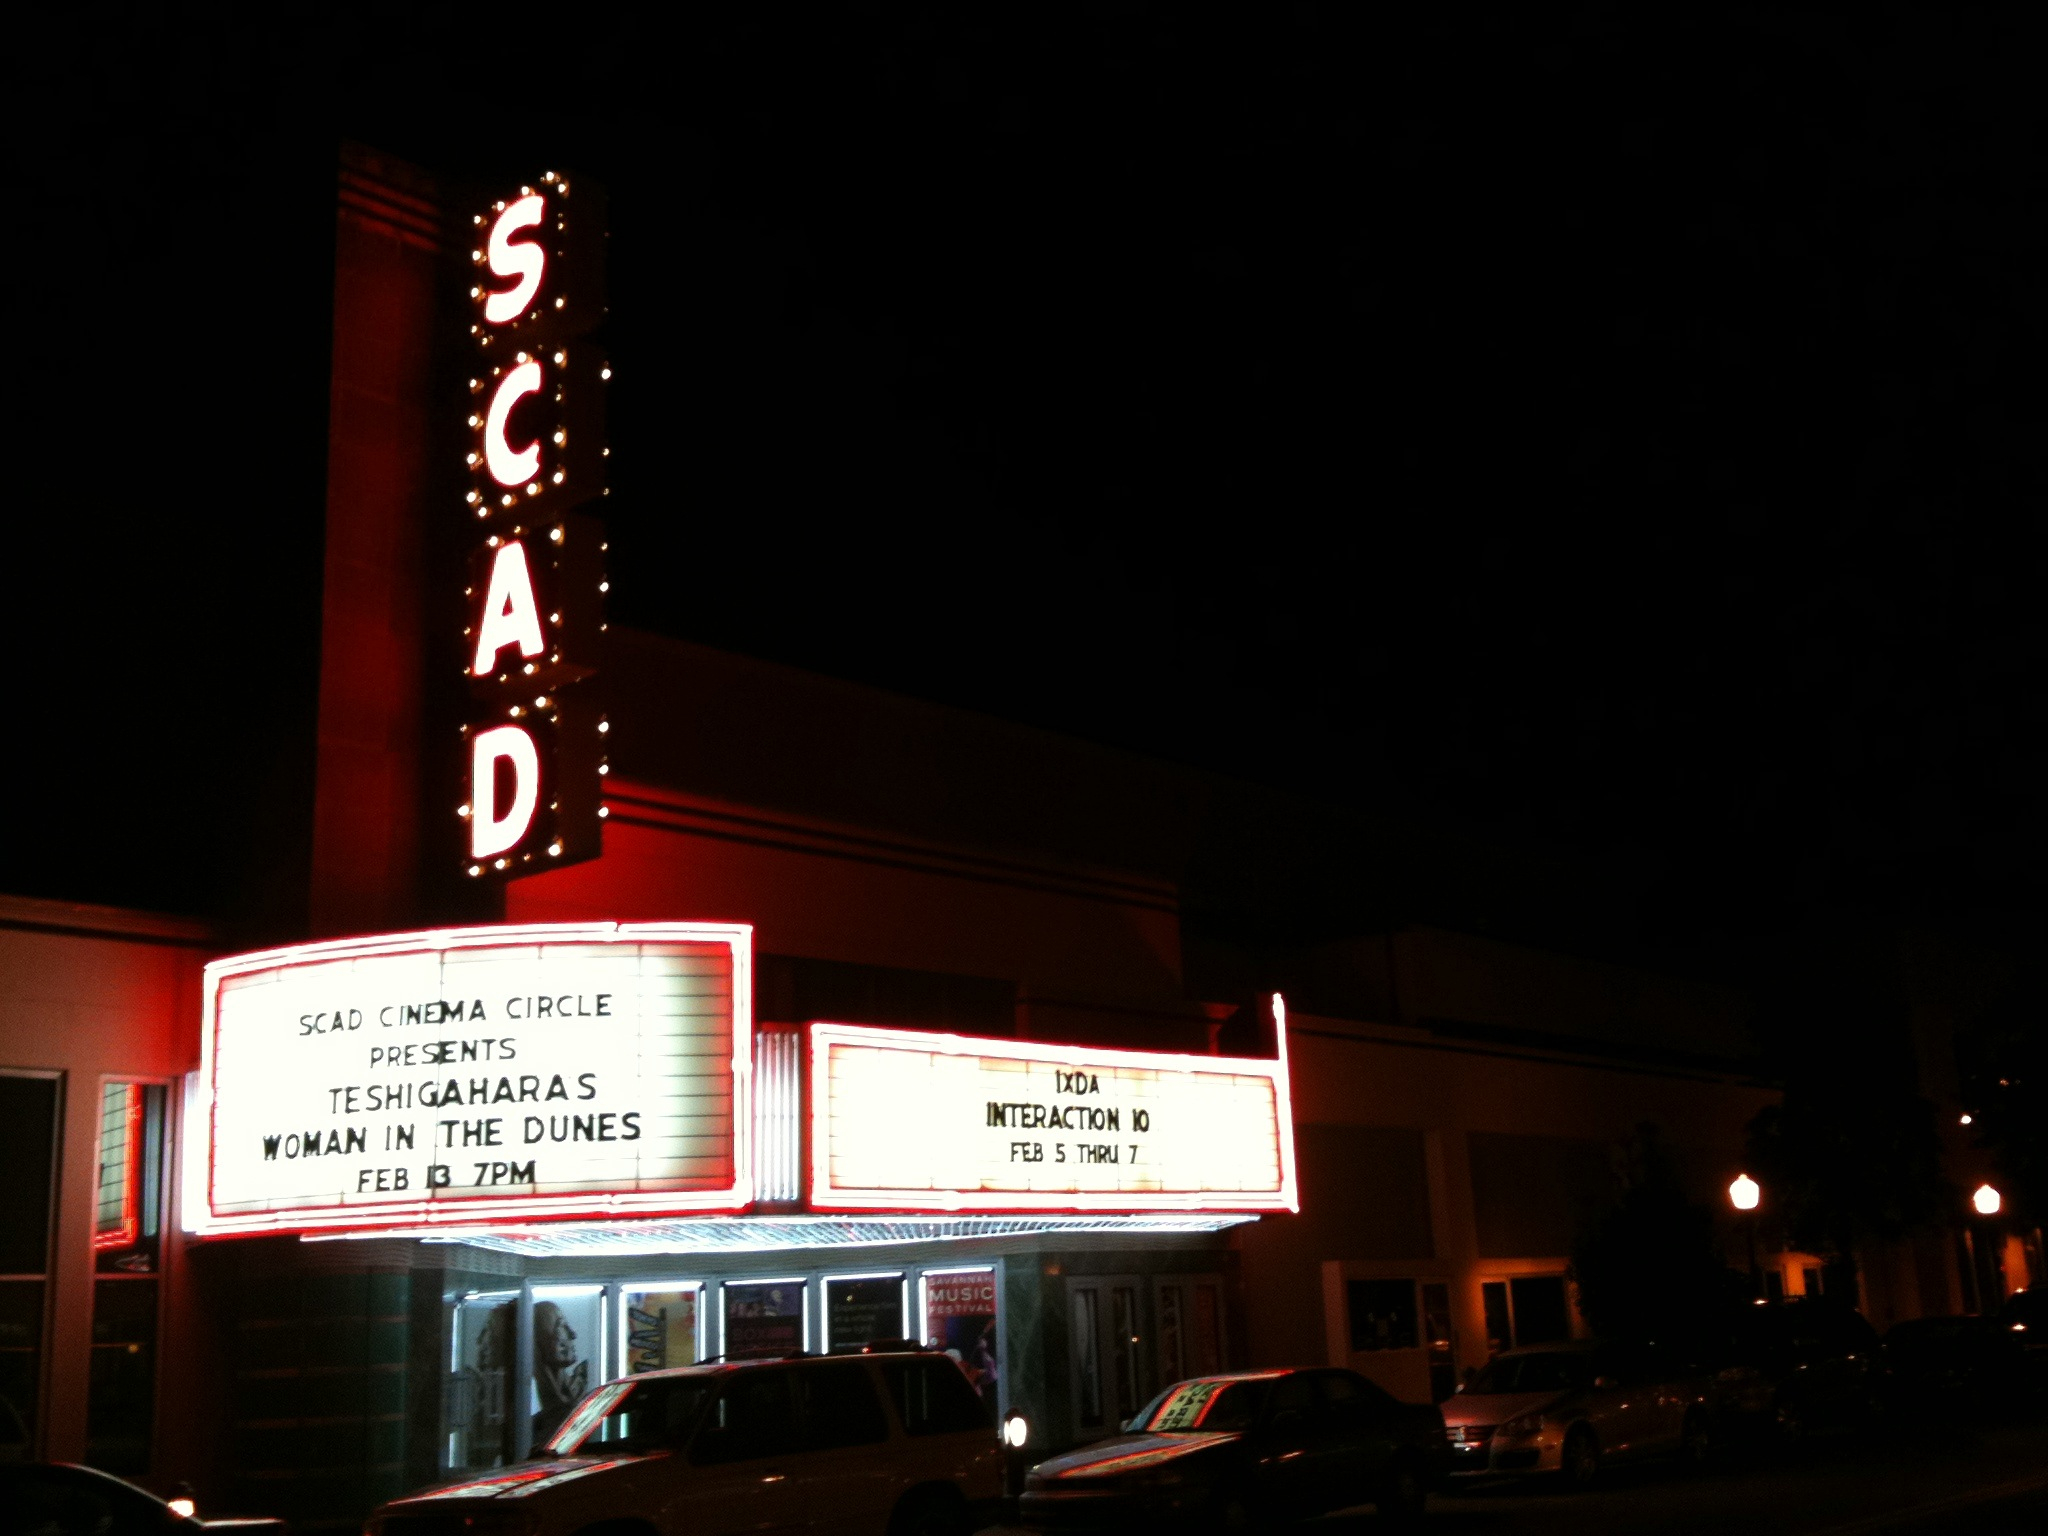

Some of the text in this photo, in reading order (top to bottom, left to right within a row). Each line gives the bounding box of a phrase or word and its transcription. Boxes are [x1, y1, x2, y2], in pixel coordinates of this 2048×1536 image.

[471, 192, 546, 860] SCAD
[300, 994, 612, 1036] SCAD CINEMA CIRCLE
[370, 1038, 517, 1068] PRESENTS
[329, 1073, 596, 1114] TESHIGAHARAS
[1056, 1070, 1099, 1095] IXDA
[986, 1102, 1149, 1132] INTERACTION 10
[263, 1113, 641, 1159] WOMAN IN THE DUNES
[1010, 1142, 1138, 1164] FEB 5 THRU 7
[357, 1161, 535, 1192] FEB 13 7PM
[929, 1275, 993, 1285] SAVANNAH
[929, 1287, 993, 1301] MUSIC
[929, 1305, 992, 1313] FESTIVAL
